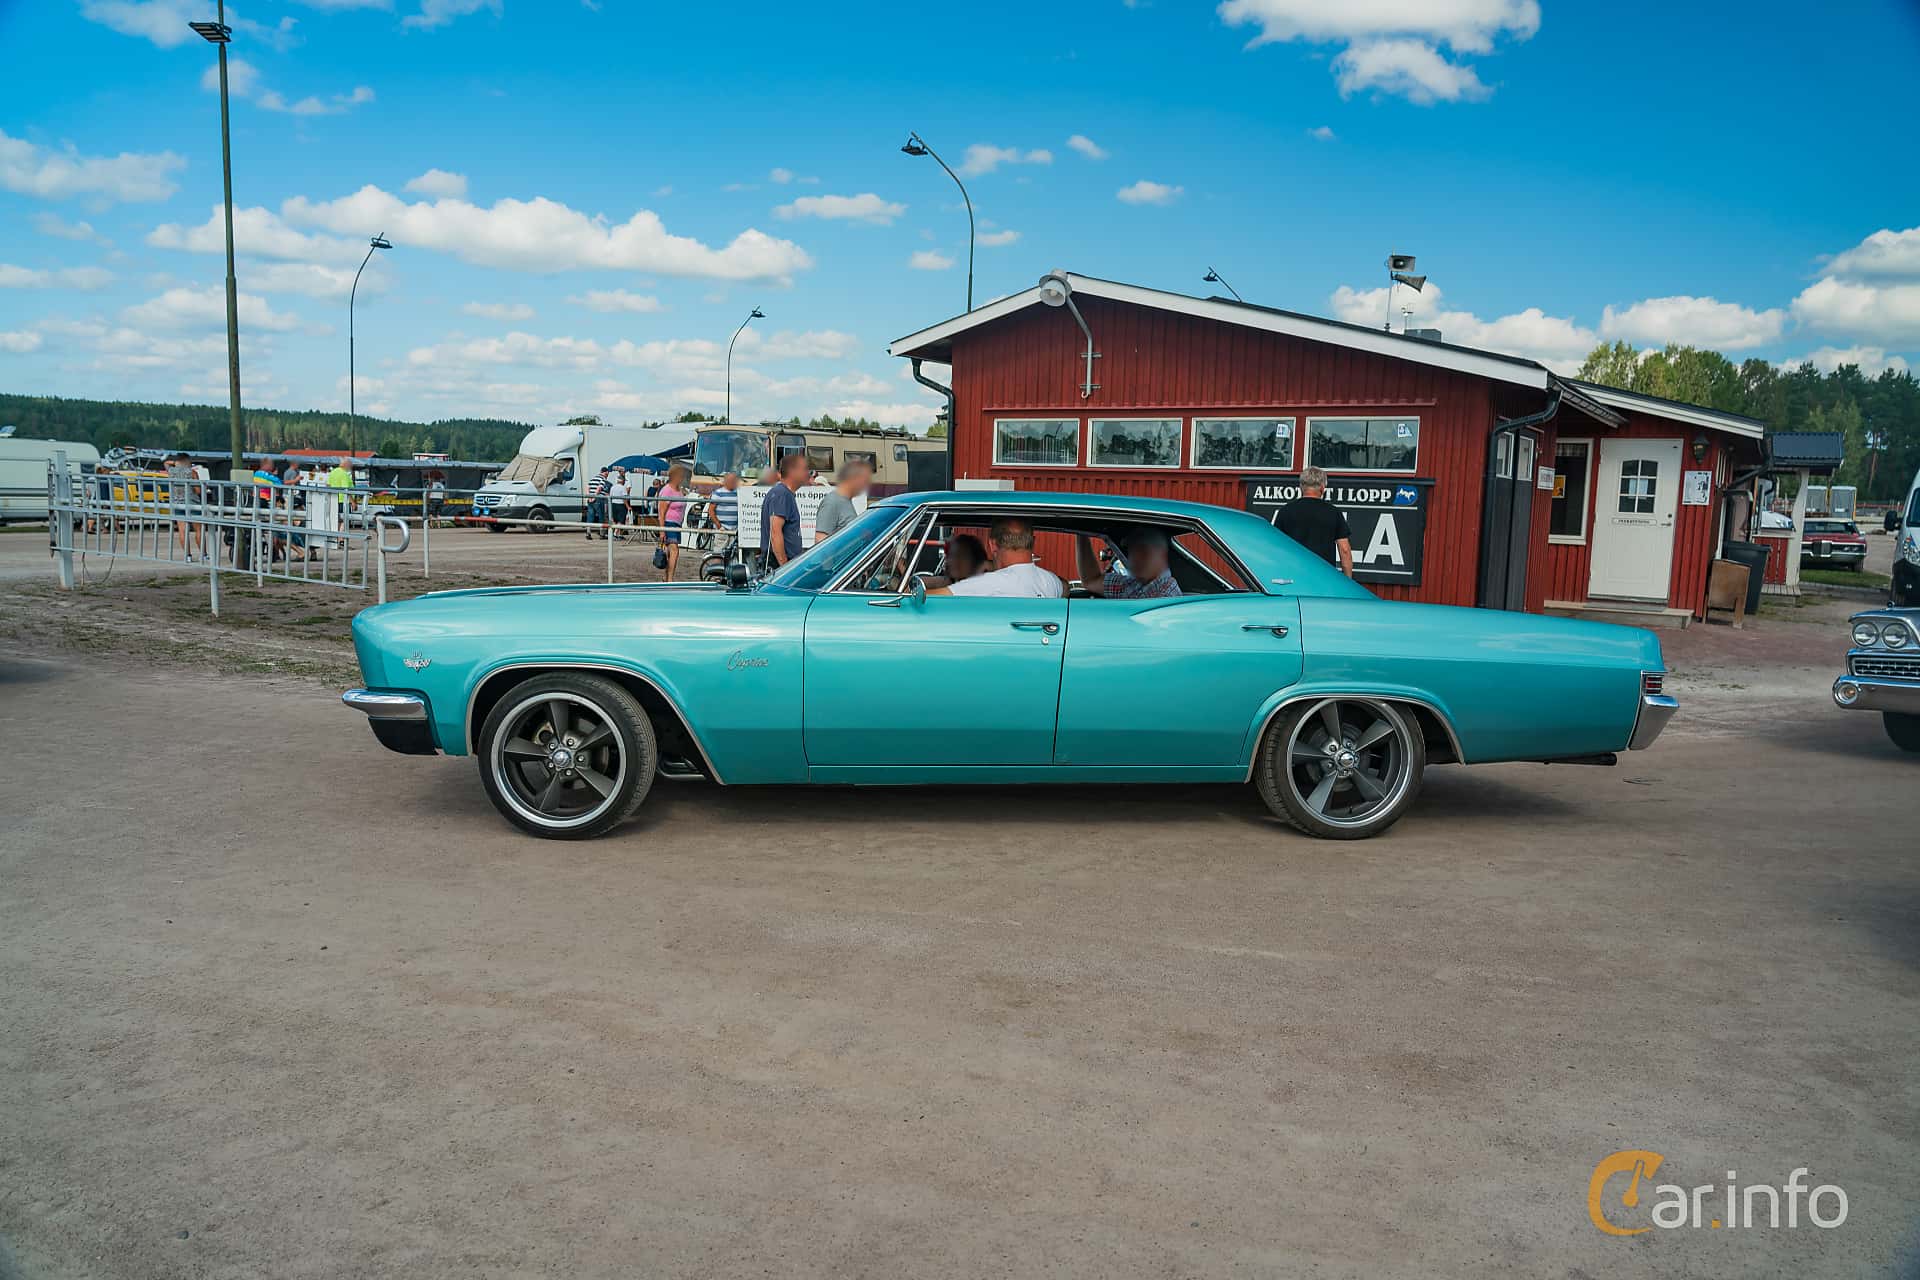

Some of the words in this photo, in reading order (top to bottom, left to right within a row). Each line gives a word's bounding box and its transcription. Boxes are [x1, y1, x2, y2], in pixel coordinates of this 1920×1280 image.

[1253, 485, 1334, 502] ALKOTT
[1337, 488, 1344, 502] I
[1348, 488, 1391, 503] LOPP
